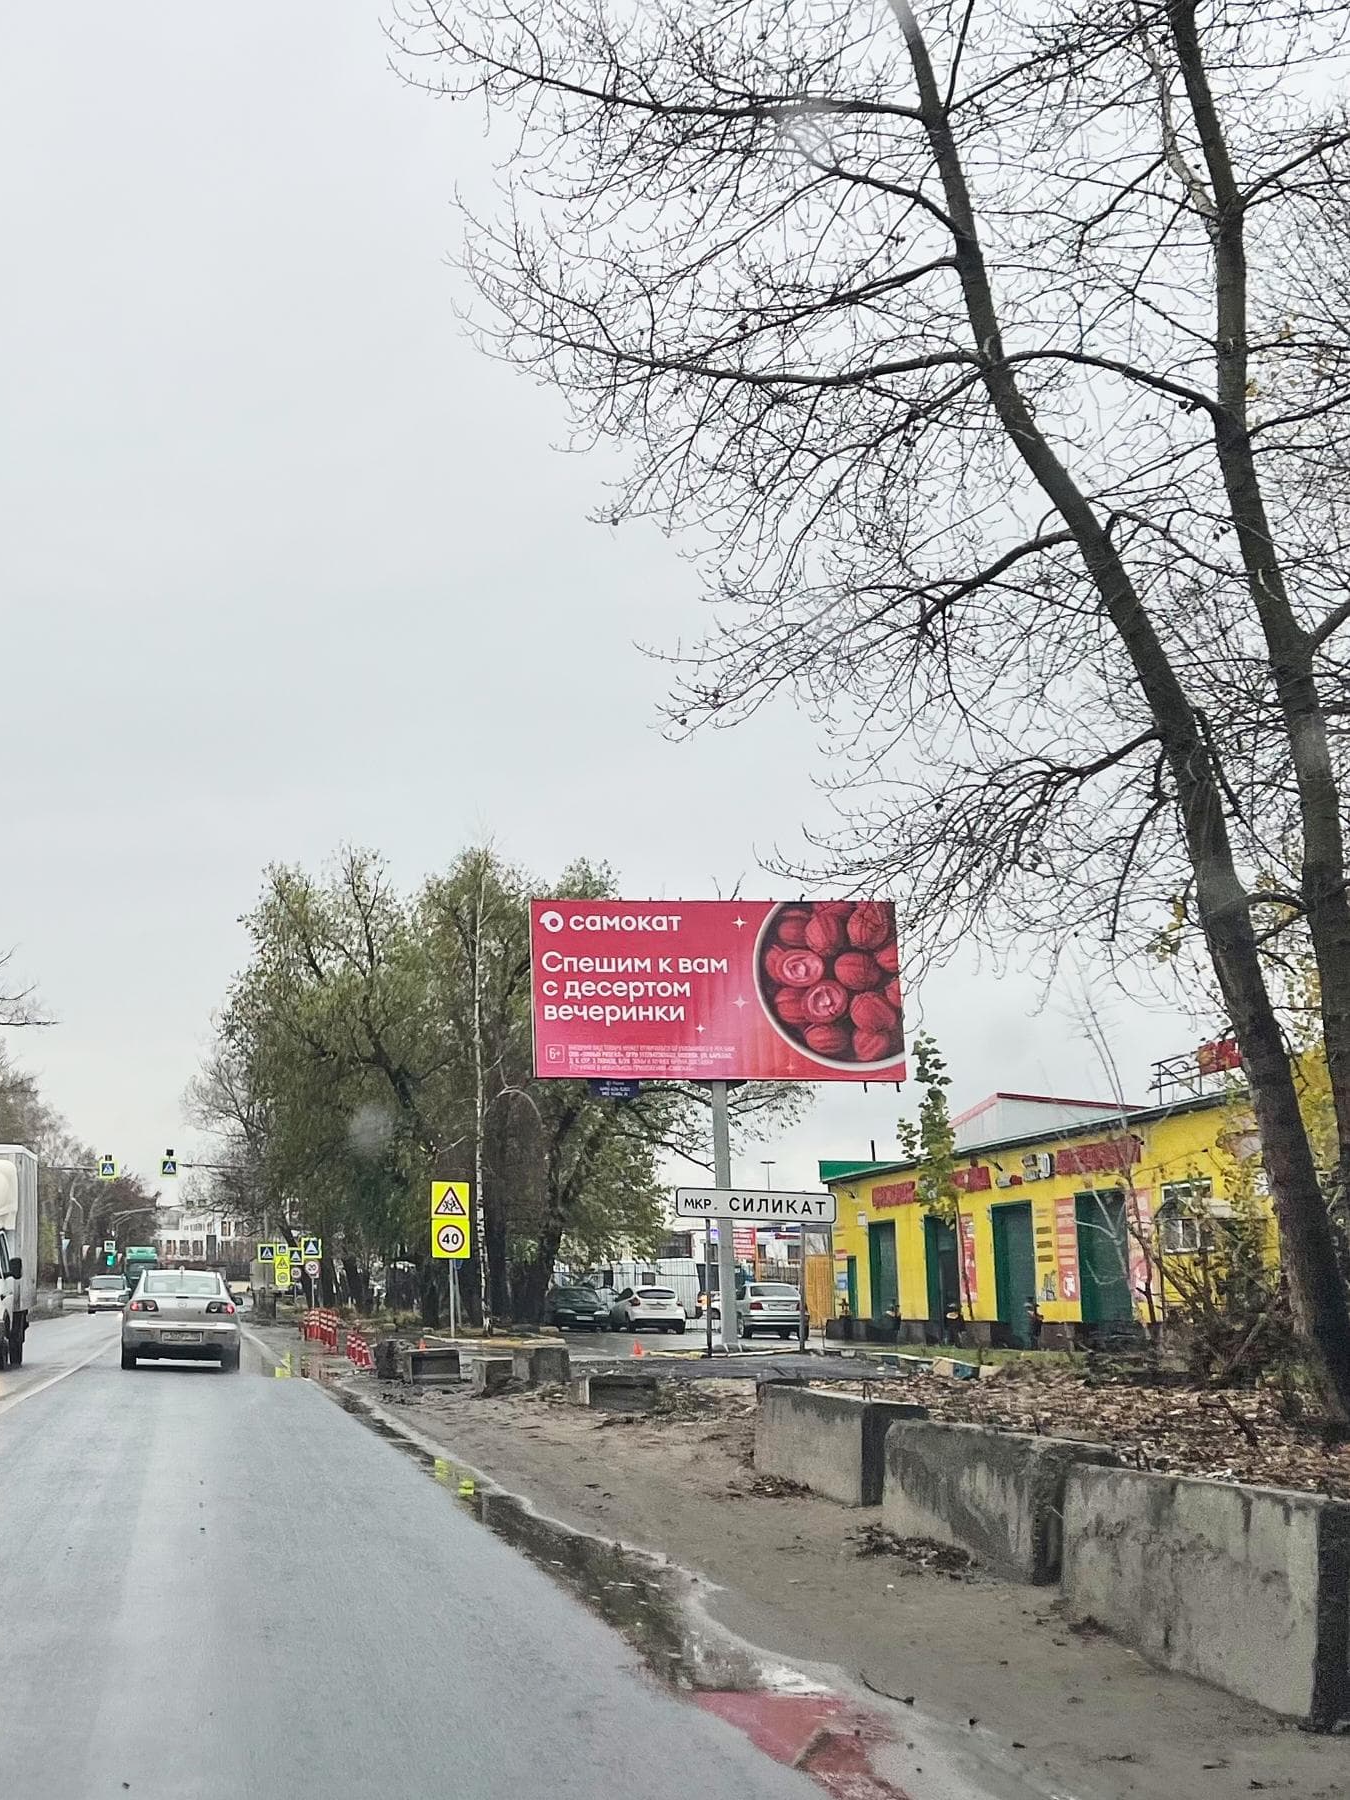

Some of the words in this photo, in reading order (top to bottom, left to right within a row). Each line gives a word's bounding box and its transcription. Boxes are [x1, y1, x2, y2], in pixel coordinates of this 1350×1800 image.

[569, 912, 682, 932] самокат
[541, 951, 651, 974] Спешим
[658, 959, 673, 974] к
[680, 957, 728, 975] вам
[542, 981, 559, 998] с
[564, 979, 691, 1001] десертом
[543, 1003, 685, 1026] вечеринки
[549, 1046, 561, 1061] 6+
[729, 1197, 827, 1216] СИЛИКАТ
[441, 1232, 460, 1246] 40
